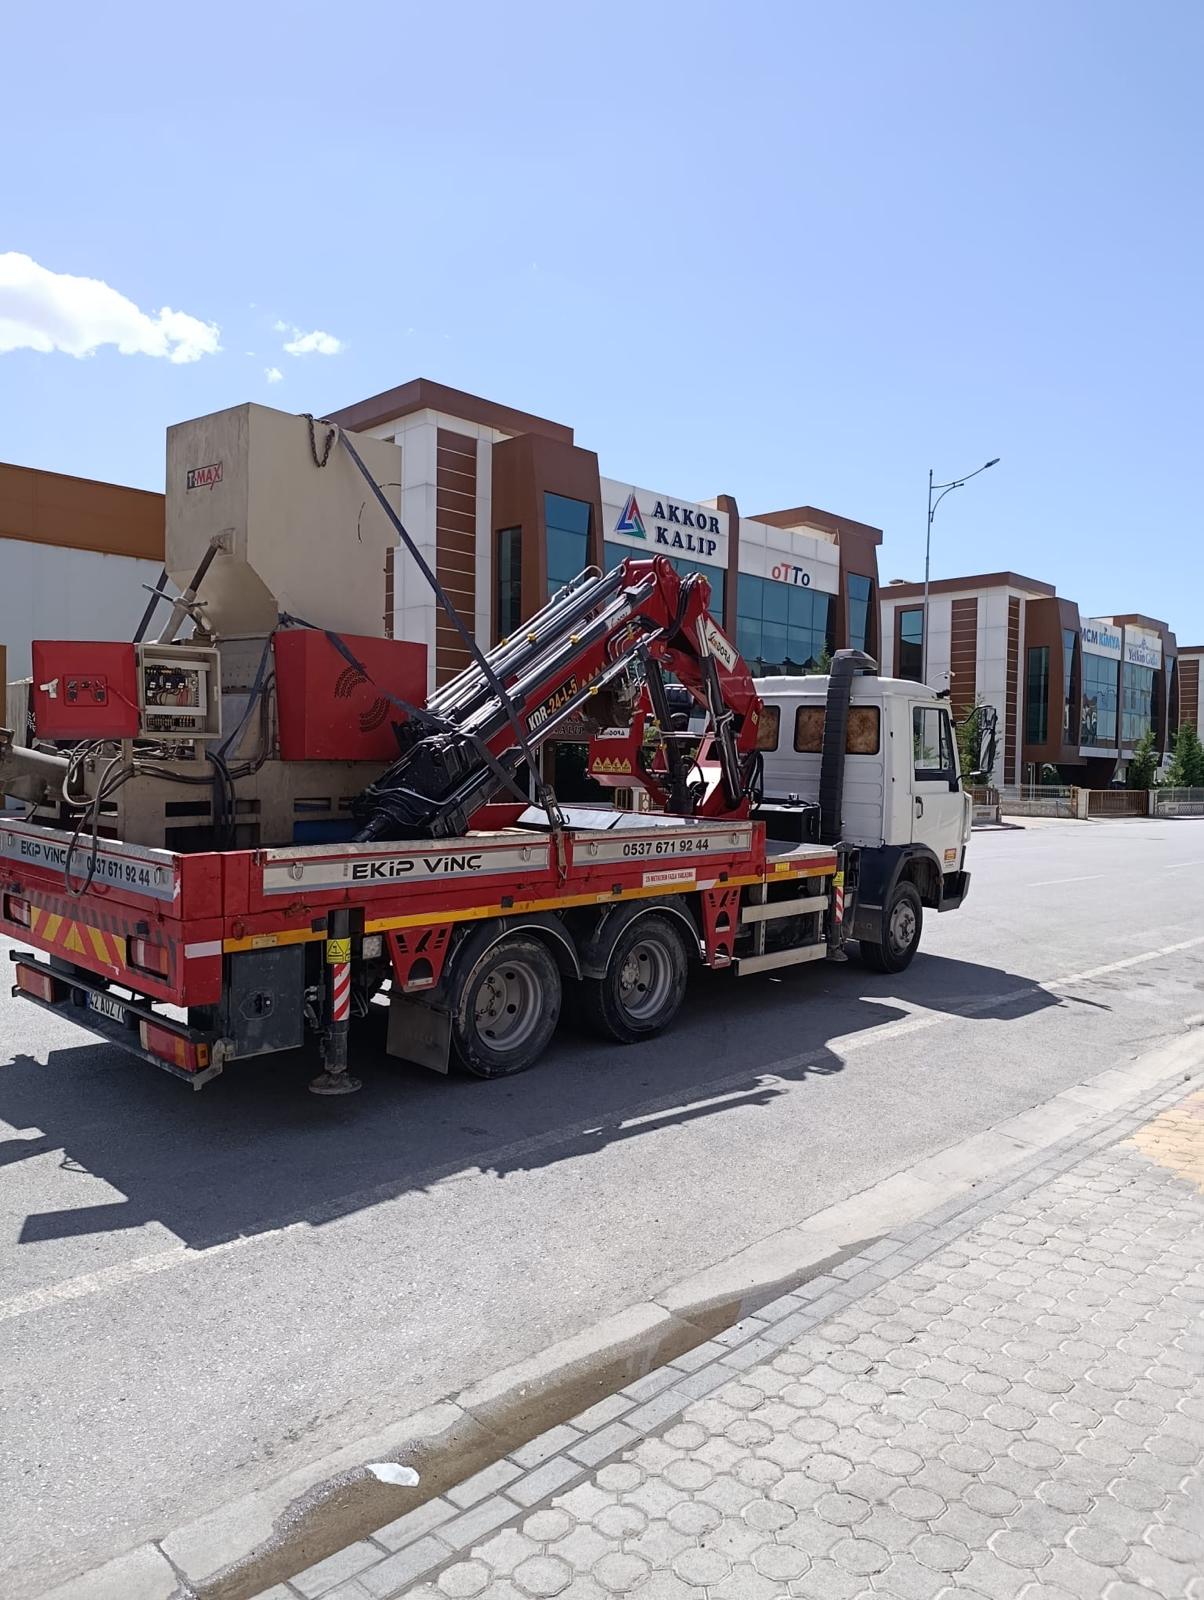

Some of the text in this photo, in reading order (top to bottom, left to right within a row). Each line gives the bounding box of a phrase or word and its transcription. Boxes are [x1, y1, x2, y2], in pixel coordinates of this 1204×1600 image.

[653, 501, 720, 534] AKKOR
[656, 526, 717, 556] KALIP
[623, 838, 709, 856] 0537 671 92 44
[86, 856, 150, 886] 037 671 92 44
